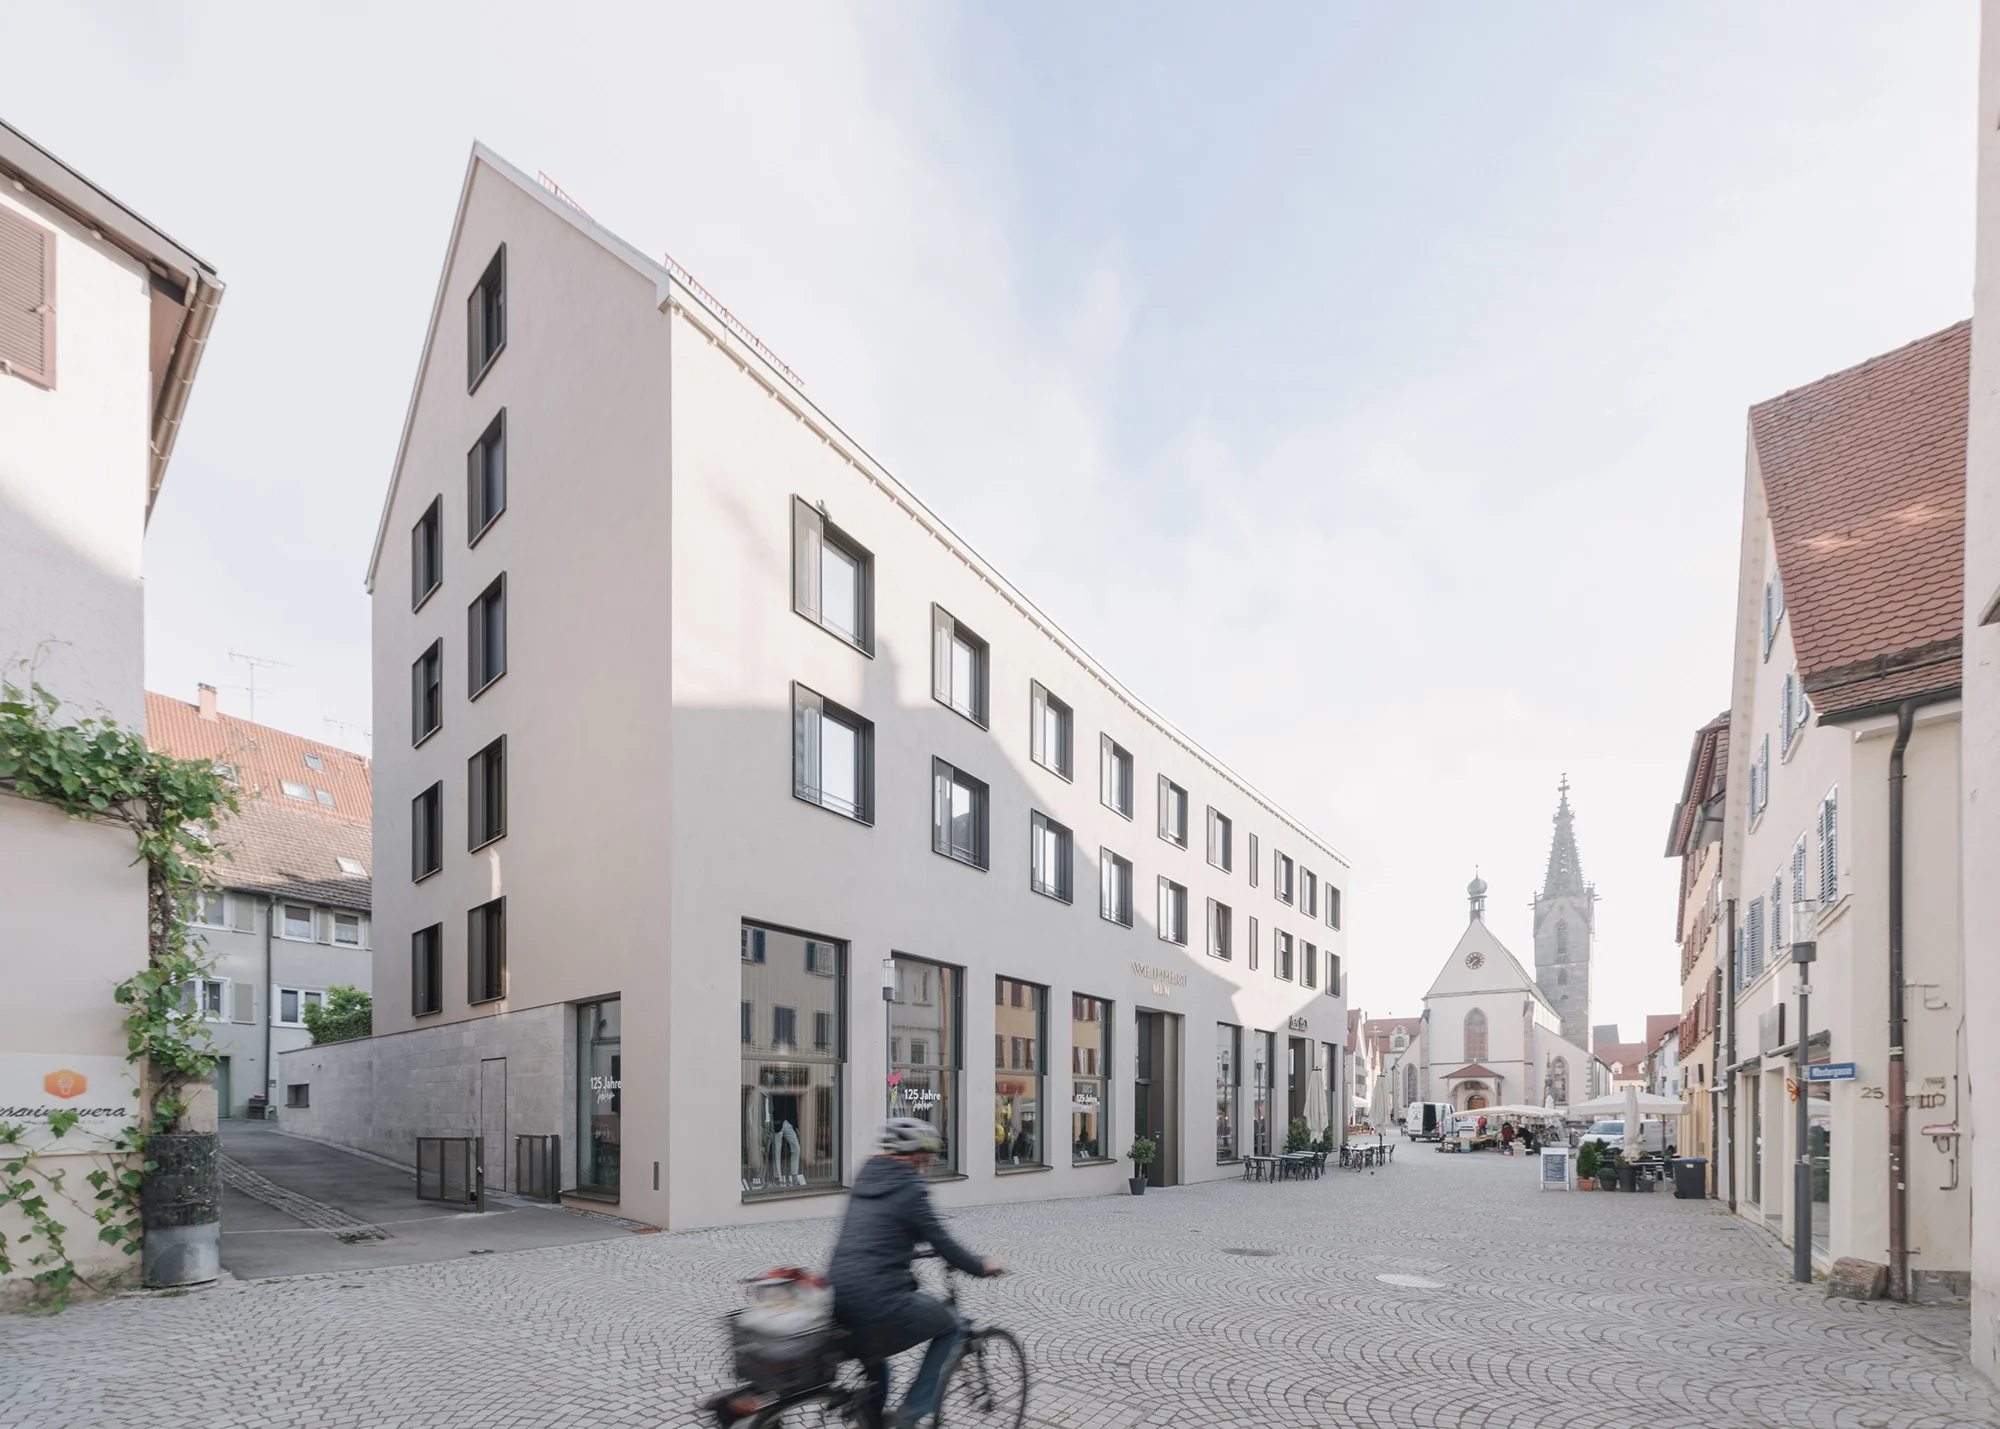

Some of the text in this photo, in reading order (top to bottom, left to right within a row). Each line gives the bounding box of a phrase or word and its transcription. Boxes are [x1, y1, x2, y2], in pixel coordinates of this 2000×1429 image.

[590, 1075, 622, 1090] 125 Jahre
[904, 1088, 941, 1100] 125 Jahre
[1860, 1086, 1885, 1099] 25
